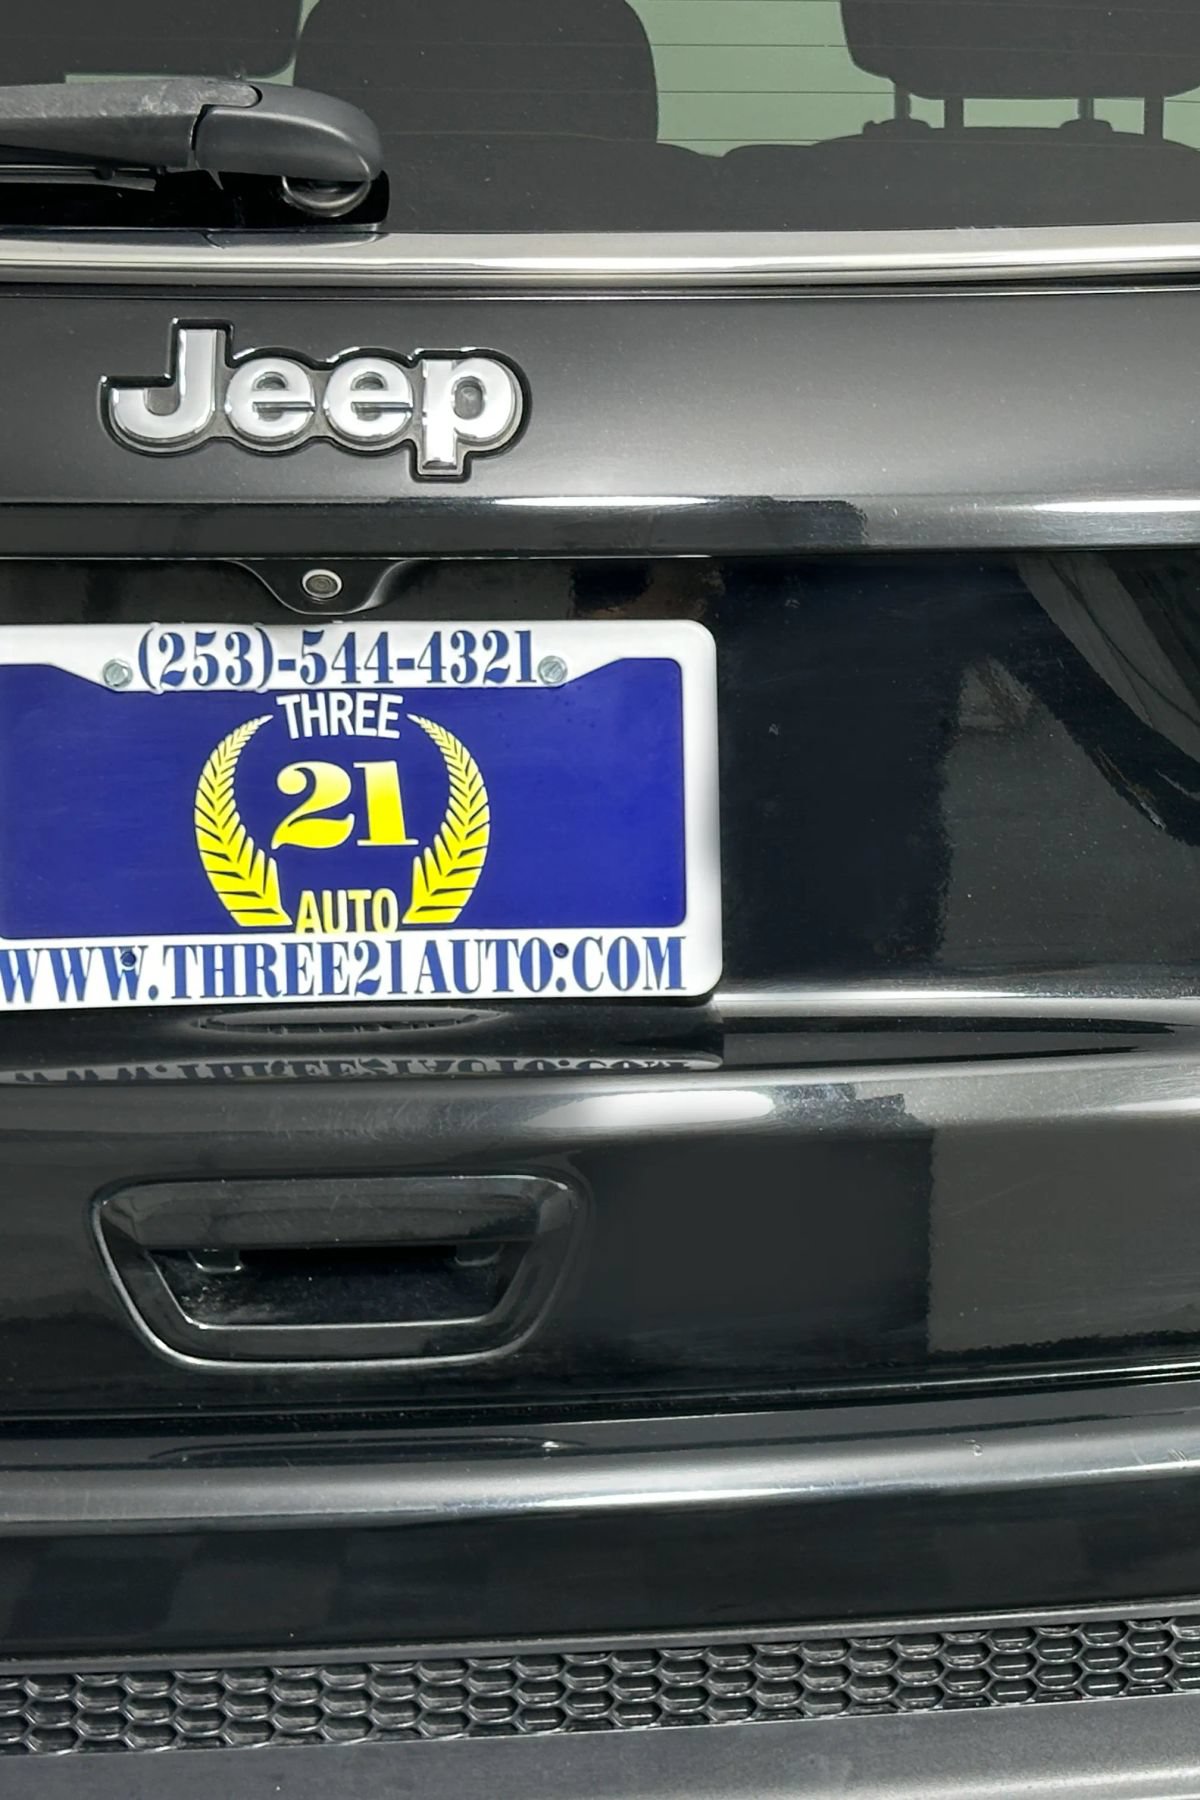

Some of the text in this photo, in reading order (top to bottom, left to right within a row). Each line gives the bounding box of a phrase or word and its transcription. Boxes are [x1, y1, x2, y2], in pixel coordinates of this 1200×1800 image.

[109, 328, 522, 474] Jeep
[137, 625, 538, 692] (253)-544-4321
[277, 693, 403, 740] THREE
[271, 761, 418, 850] 21
[295, 889, 399, 934] AUTO
